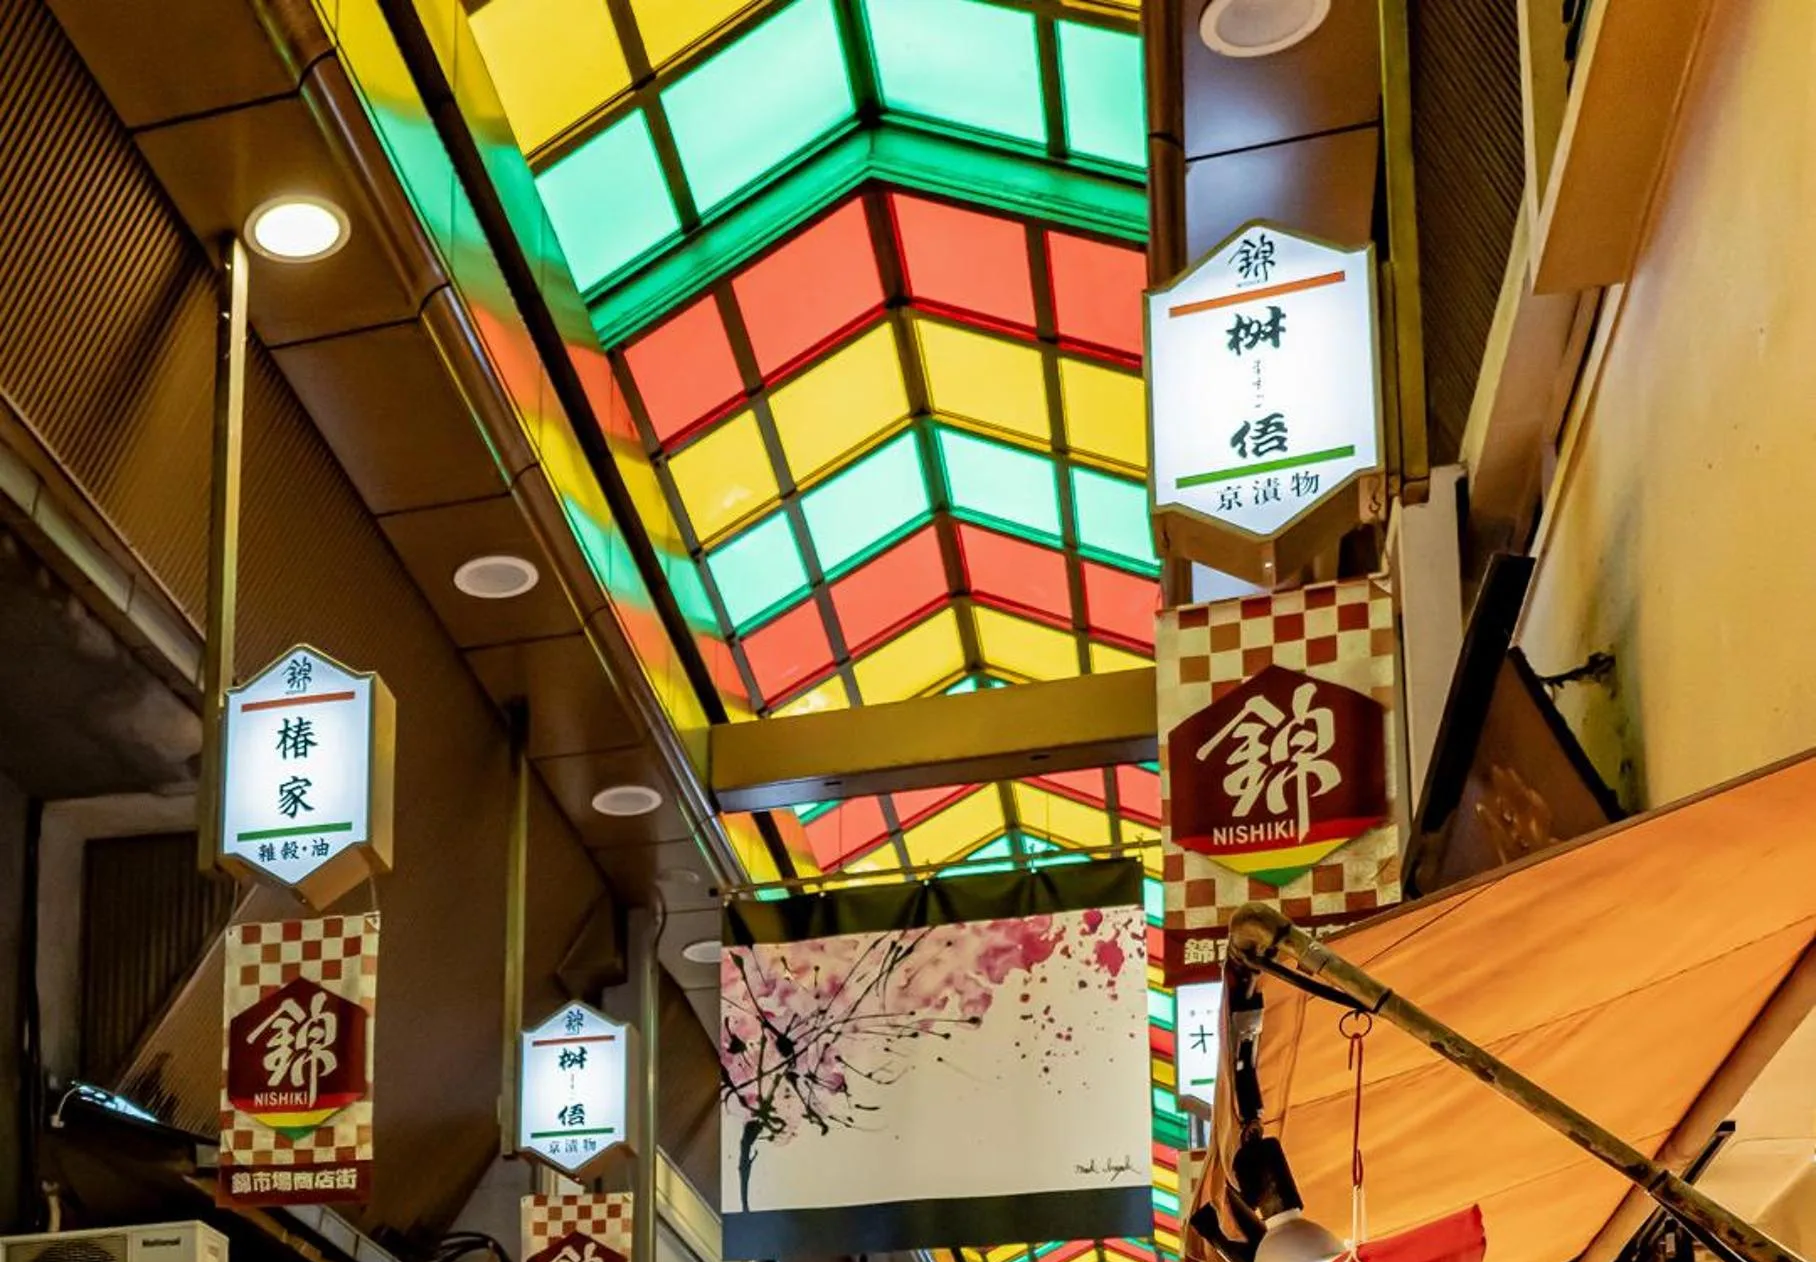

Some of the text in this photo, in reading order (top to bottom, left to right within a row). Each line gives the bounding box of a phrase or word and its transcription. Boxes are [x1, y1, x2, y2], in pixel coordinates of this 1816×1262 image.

[1216, 471, 1320, 512] 京漬物
[276, 716, 318, 819] 椿家
[1196, 683, 1342, 846] 錦
[1212, 820, 1296, 847] NISHIKI
[246, 991, 338, 1109] 錦
[254, 1091, 308, 1107] NISHIKI
[231, 1168, 357, 1195] 錦市場商店街
